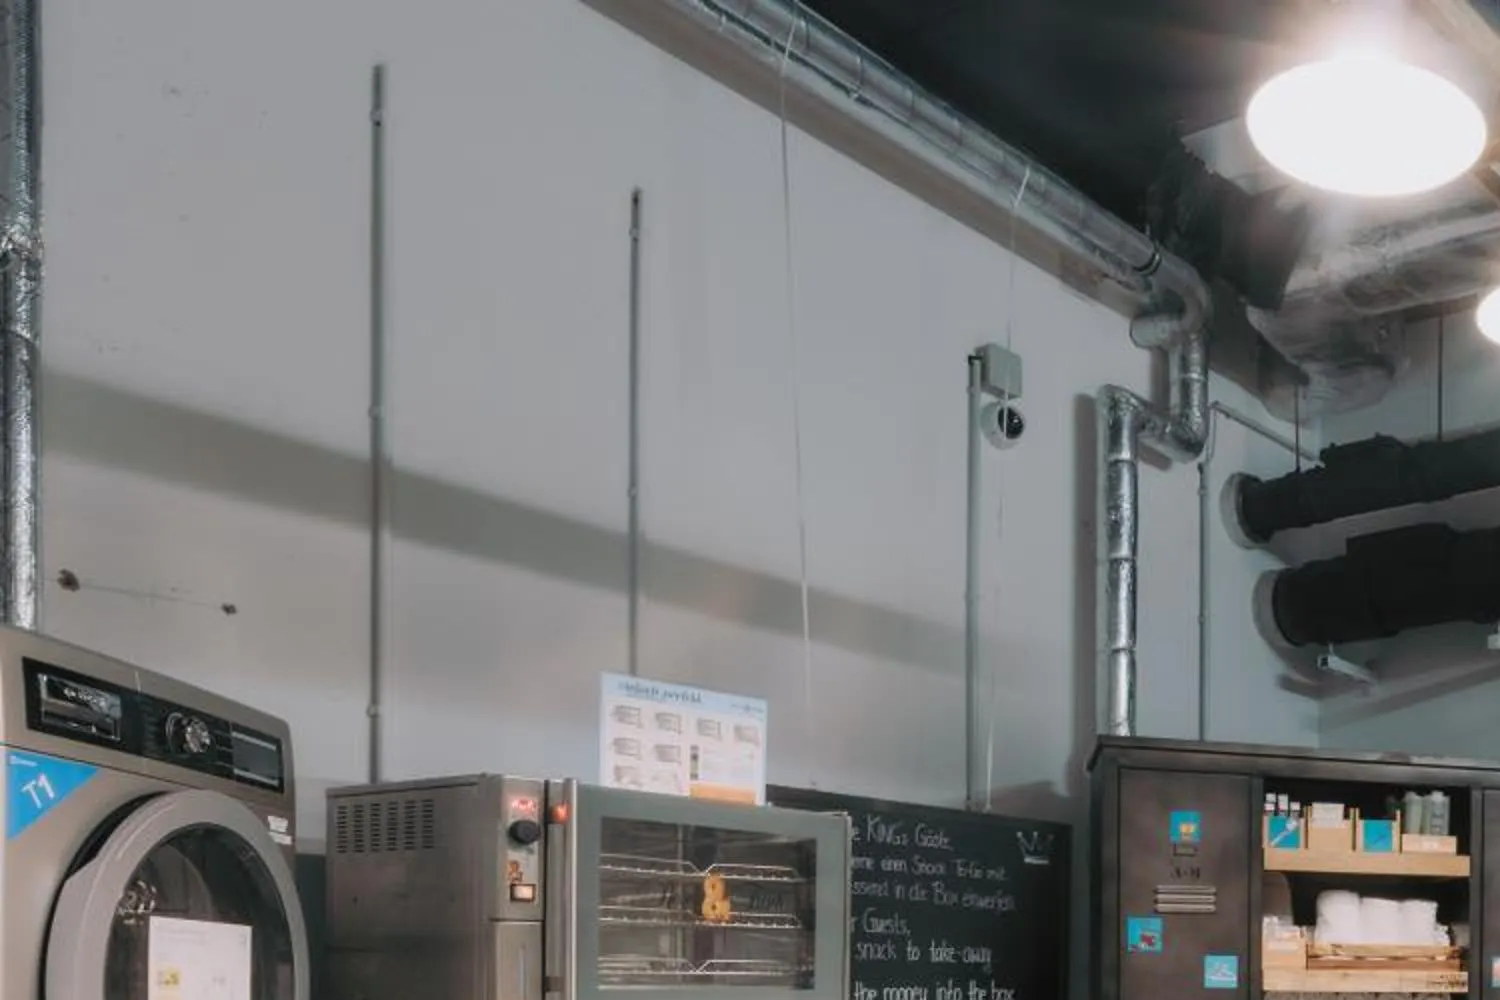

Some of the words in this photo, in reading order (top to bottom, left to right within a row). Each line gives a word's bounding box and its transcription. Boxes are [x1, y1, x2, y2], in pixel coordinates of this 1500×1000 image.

[21, 772, 55, 808] T1
[856, 940, 897, 961] snack
[905, 940, 921, 962] to
